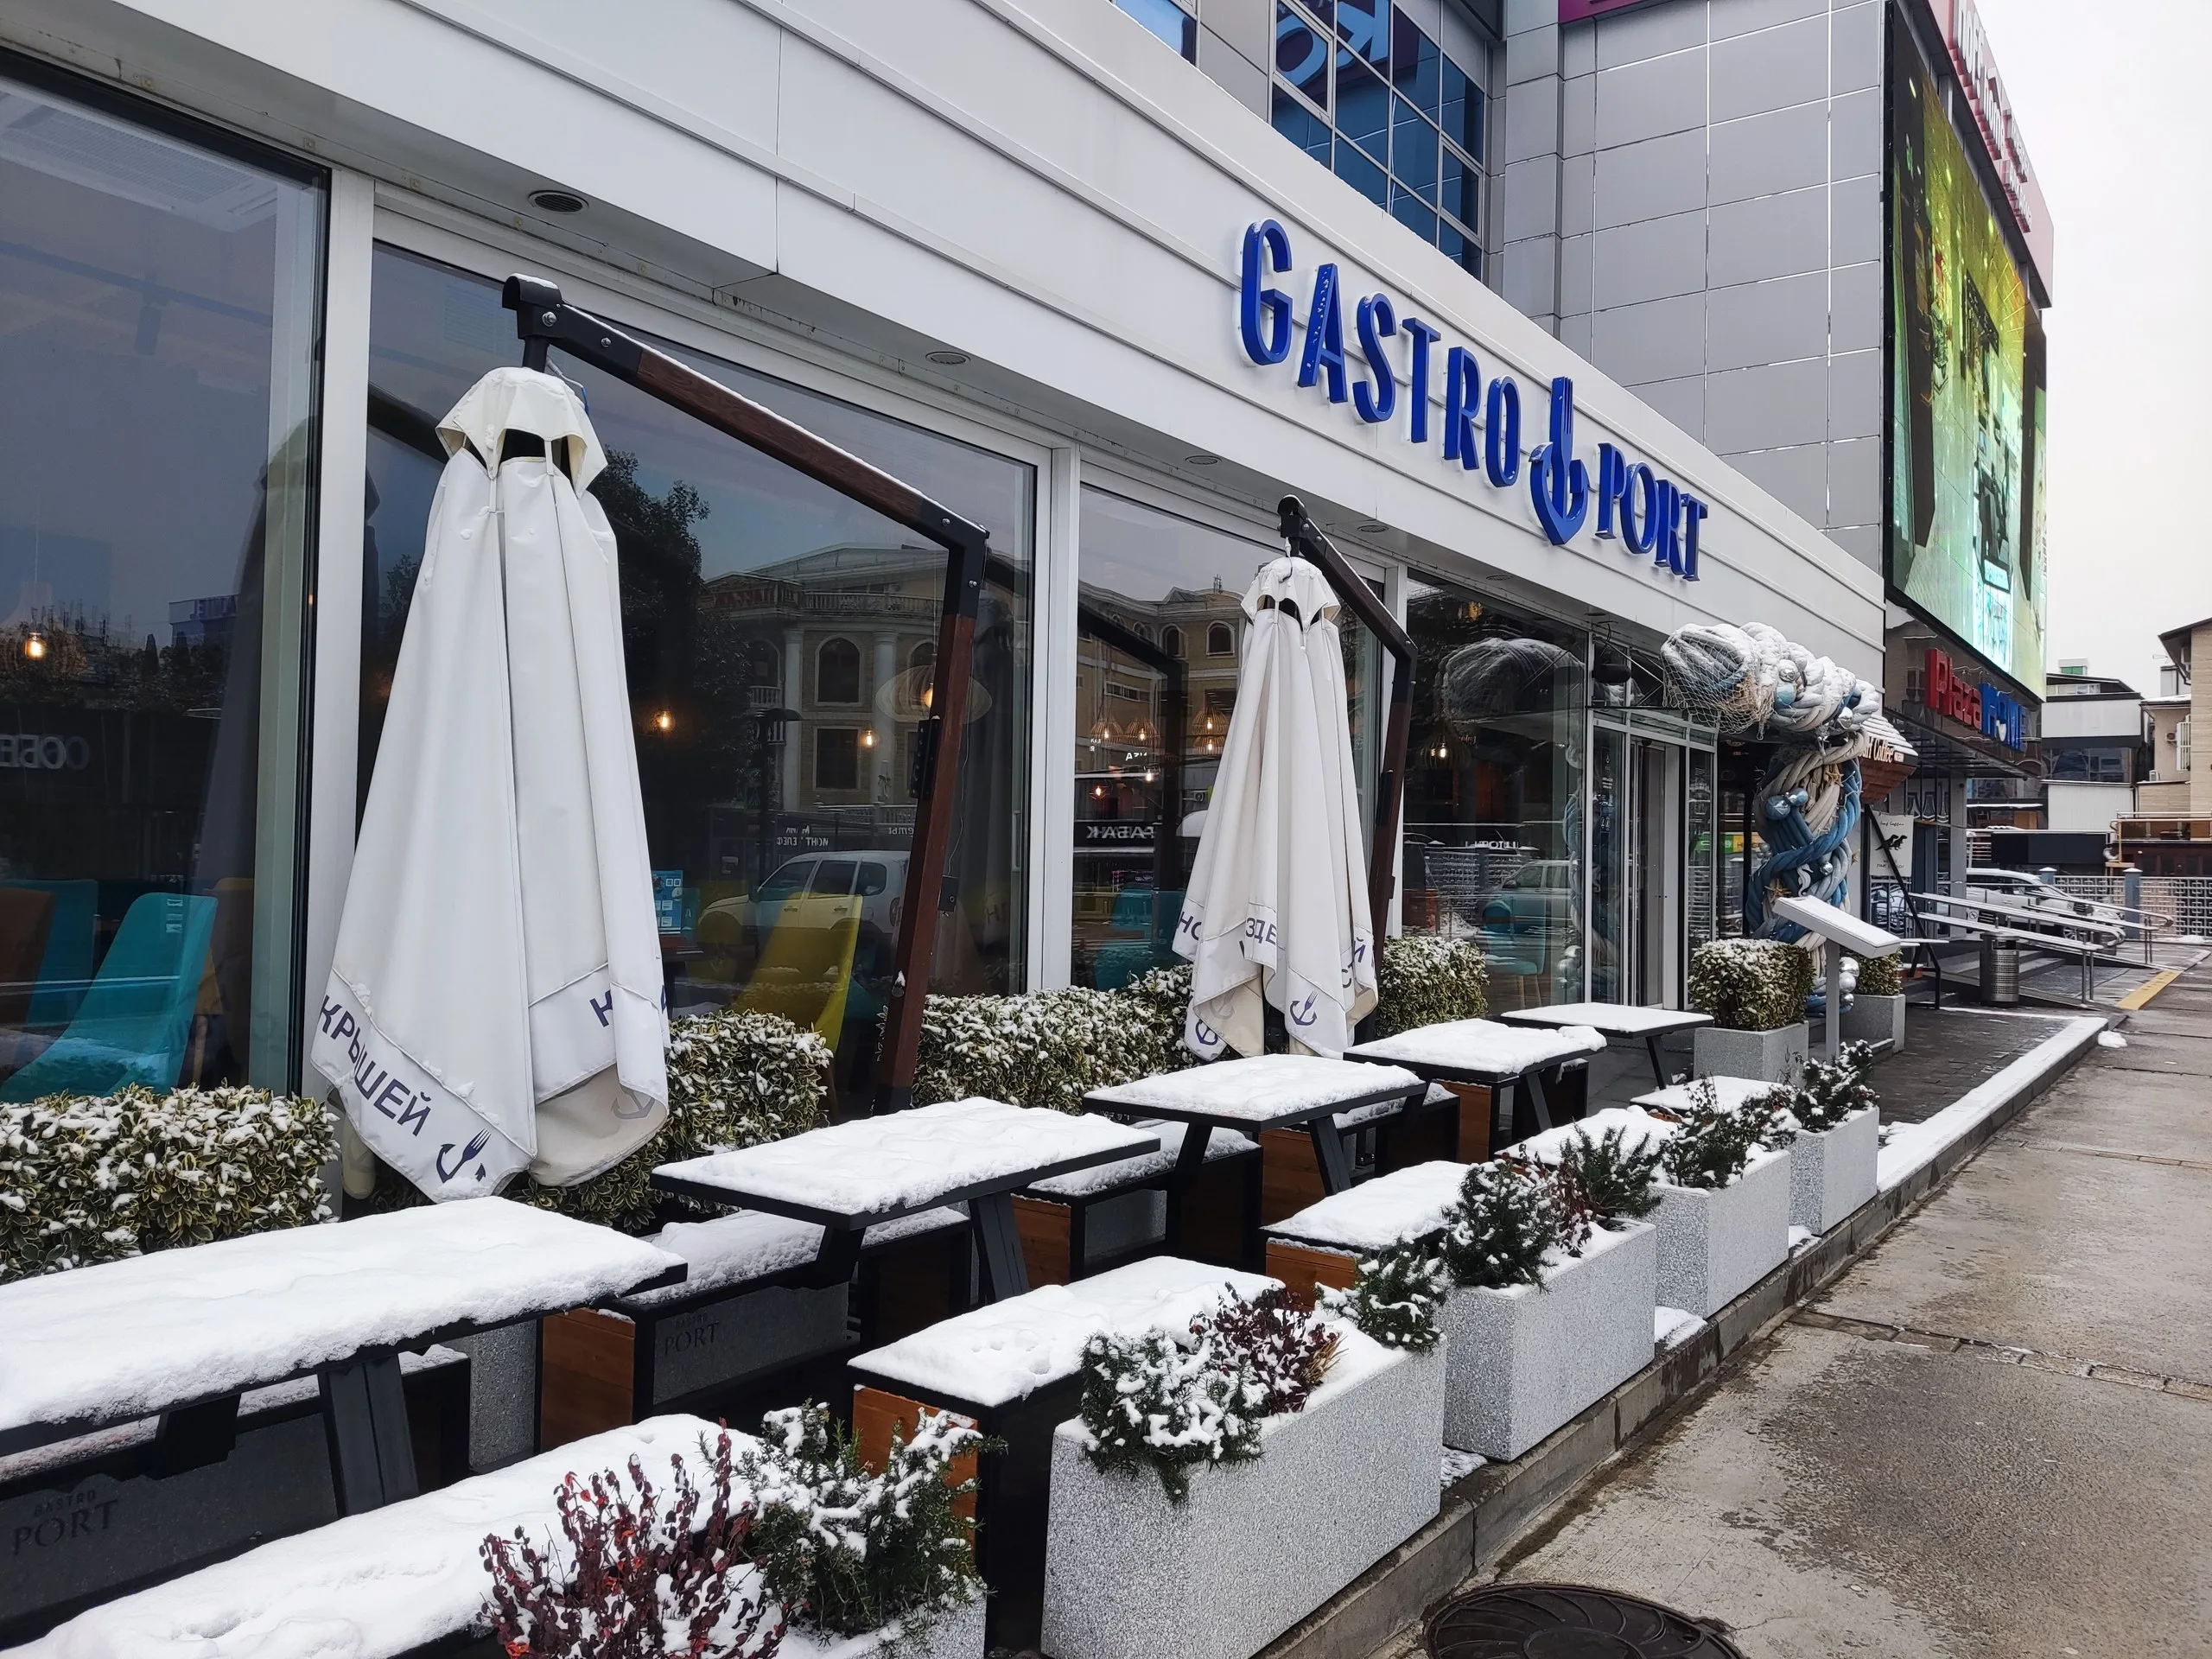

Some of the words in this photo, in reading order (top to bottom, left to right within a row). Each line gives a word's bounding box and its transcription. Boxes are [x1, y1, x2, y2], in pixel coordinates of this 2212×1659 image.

[1240, 218, 1522, 488] GASTRO
[1594, 442, 1709, 582] PORT
[319, 995, 432, 1138] КРЫШЕЙ
[664, 1320, 720, 1358] PORT
[11, 1498, 119, 1556] PORT
